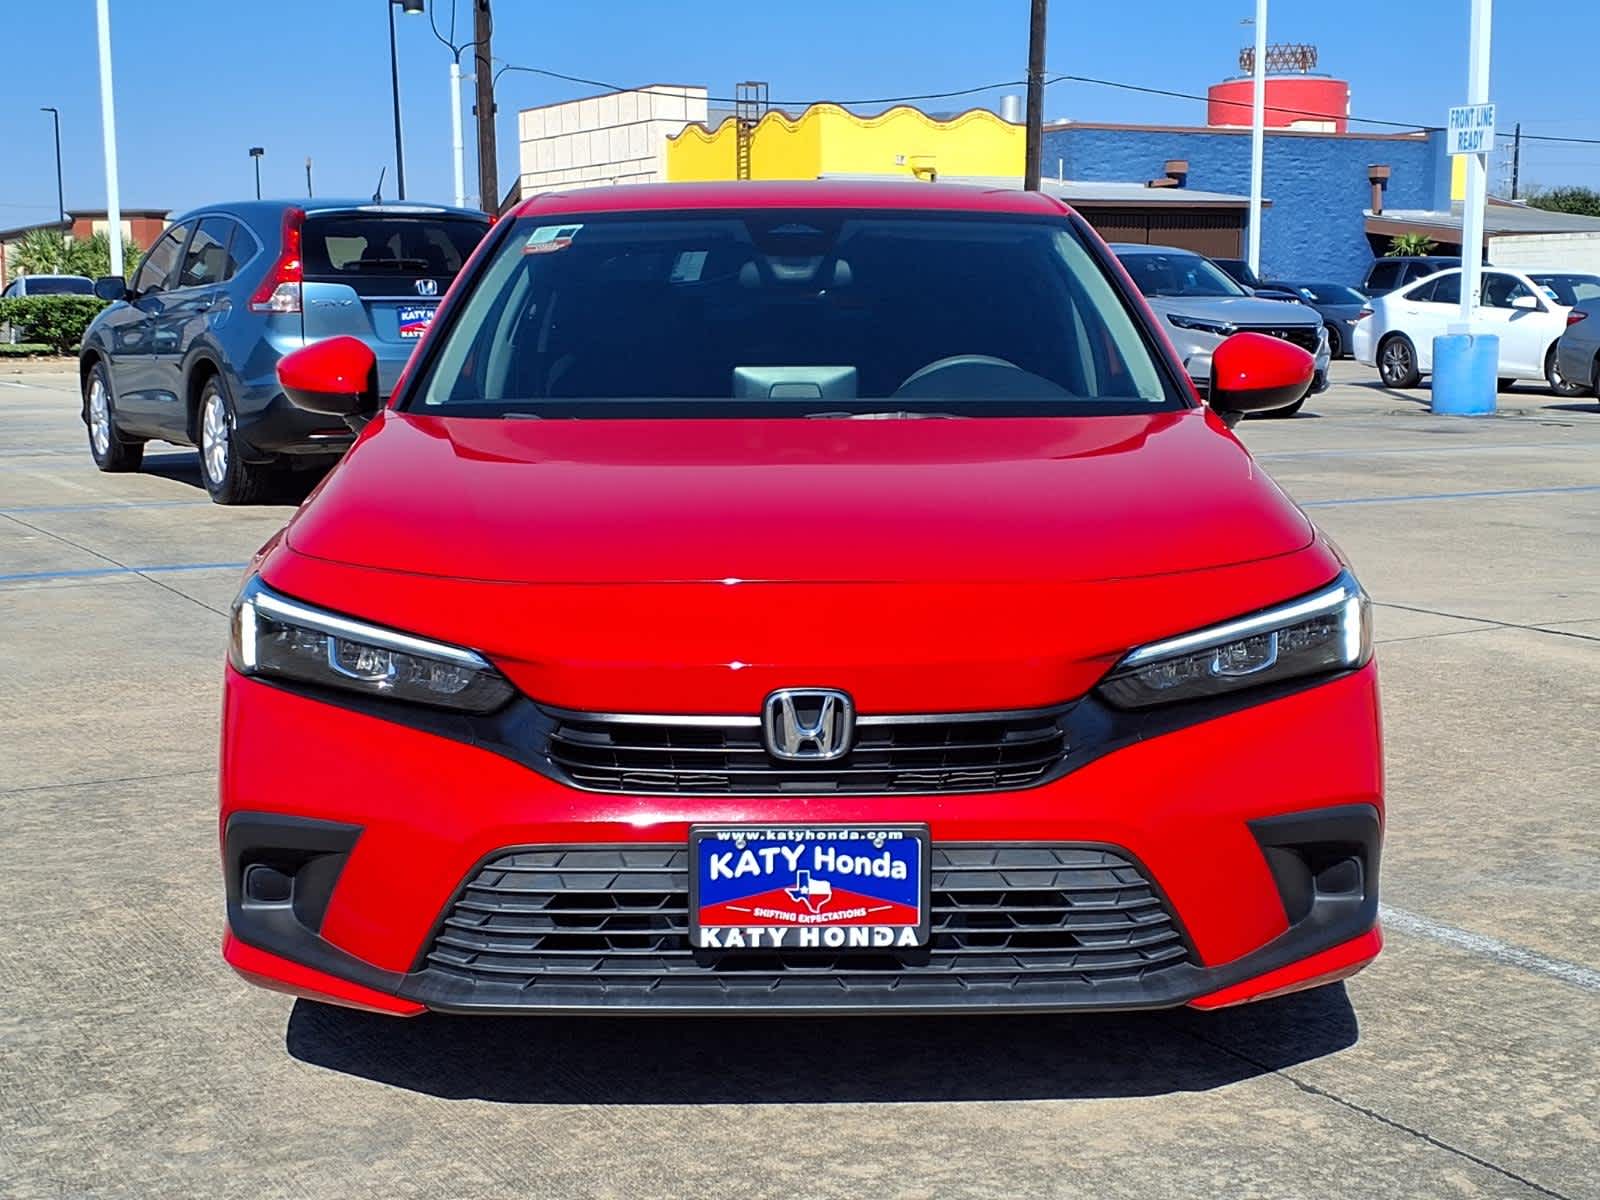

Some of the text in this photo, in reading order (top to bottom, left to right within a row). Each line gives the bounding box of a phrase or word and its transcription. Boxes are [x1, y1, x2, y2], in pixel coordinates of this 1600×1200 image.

[1451, 106, 1493, 128] FRONT LINE
[1458, 130, 1484, 150] READY
[401, 310, 426, 320] KATY
[716, 830, 904, 841] www.katyhonda.com
[710, 844, 907, 880] KATY Honda
[753, 907, 867, 923] SHIFTING EXPECTATIONS
[701, 926, 919, 947] KATY HONDA
